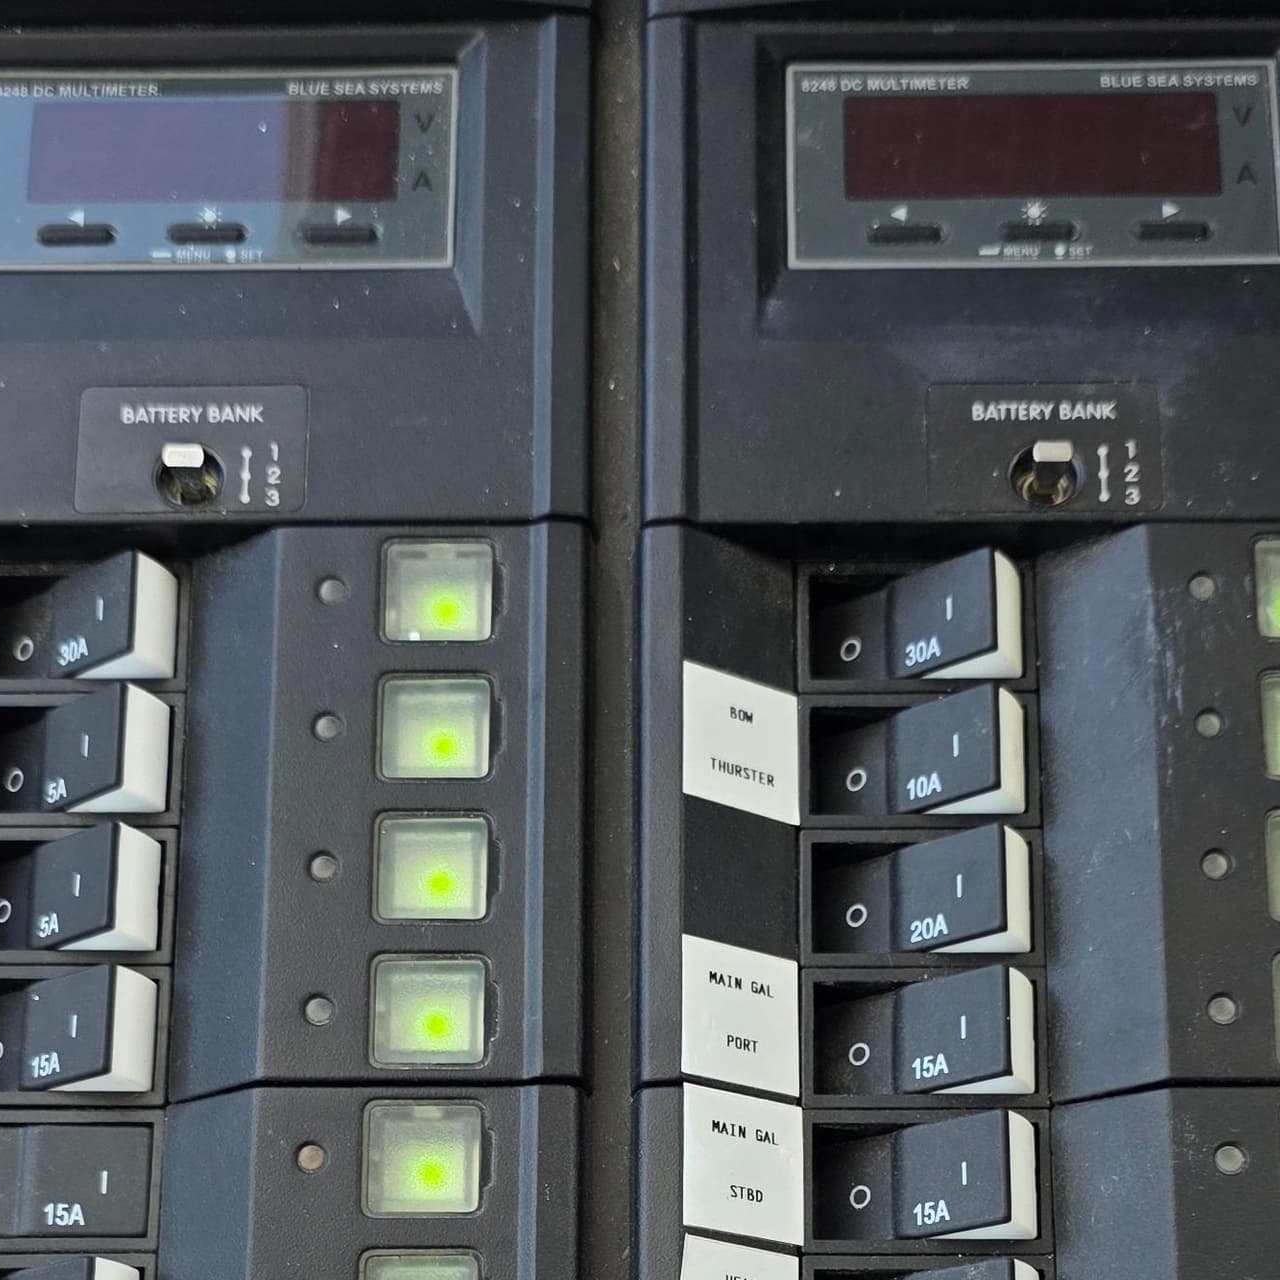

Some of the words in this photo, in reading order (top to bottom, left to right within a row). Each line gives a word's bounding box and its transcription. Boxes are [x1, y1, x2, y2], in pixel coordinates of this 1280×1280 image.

[32, 83, 55, 97] DC
[58, 81, 159, 97] MULTIMETER
[287, 80, 331, 96] BLUE
[334, 79, 365, 96] SEA
[369, 77, 444, 96] SYSTEMS
[800, 79, 838, 93] 8248
[840, 78, 864, 92] DC
[866, 76, 970, 91] MULTIMETER
[1099, 73, 1143, 88] BLUE
[1146, 73, 1180, 88] SEA
[1182, 71, 1260, 88] SYSTEMS
[1232, 106, 1255, 127] V
[1236, 163, 1258, 185] A
[1002, 245, 1040, 258] MENU
[1068, 245, 1094, 258] SET
[121, 403, 204, 425] BATTERY
[207, 401, 265, 424] BANK
[971, 401, 1056, 421] BATTERY
[1058, 400, 1118, 420] BANK
[269, 441, 280, 462] 1
[1124, 438, 1138, 459] 1
[266, 464, 281, 485] 2
[1123, 461, 1141, 482] 2
[265, 487, 281, 507] 3
[1124, 484, 1142, 506] 3
[57, 636, 89, 666] 30A
[905, 635, 941, 667] 30A
[729, 706, 754, 724] BOW
[709, 756, 776, 788] THURSTER
[46, 777, 67, 804] 5A
[906, 770, 942, 801] 10A
[36, 913, 60, 938] 5A
[909, 912, 949, 943] 20A
[708, 969, 743, 991] MAIN
[750, 979, 775, 999] GAL
[726, 1033, 759, 1053] PORT
[30, 1052, 61, 1079] 15A
[911, 1051, 950, 1080] 15A
[711, 1119, 747, 1139] MAIN
[754, 1127, 780, 1147] GAL
[729, 1183, 764, 1204] STBD
[42, 1202, 86, 1227] 15A
[913, 1199, 951, 1227] 15A
